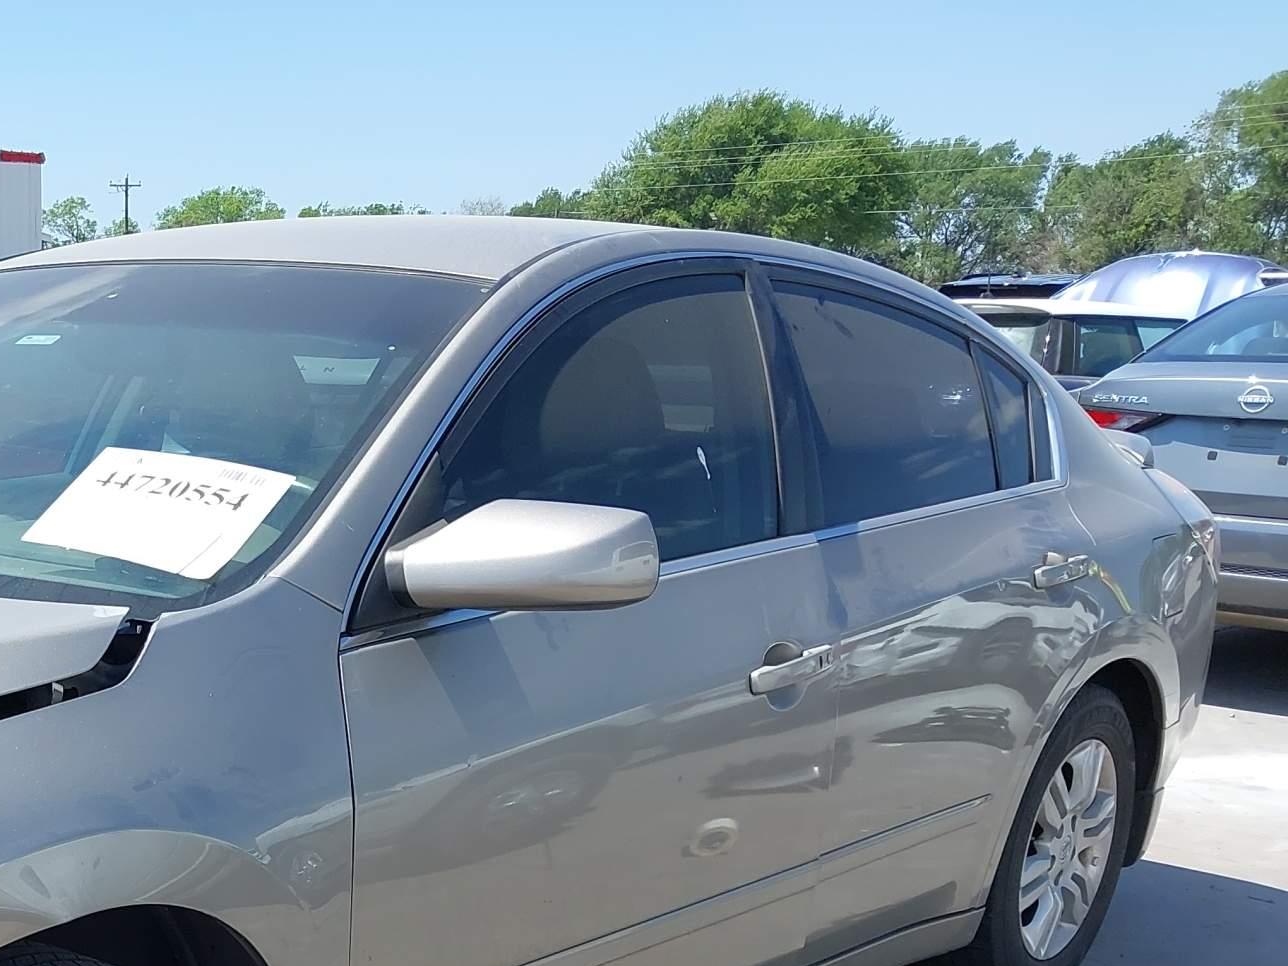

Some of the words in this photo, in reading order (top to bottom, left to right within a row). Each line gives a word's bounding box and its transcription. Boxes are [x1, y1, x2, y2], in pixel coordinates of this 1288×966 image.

[1092, 393, 1150, 405] SENTRA
[1237, 394, 1274, 404] NISSAN
[96, 471, 250, 511] 44720554
